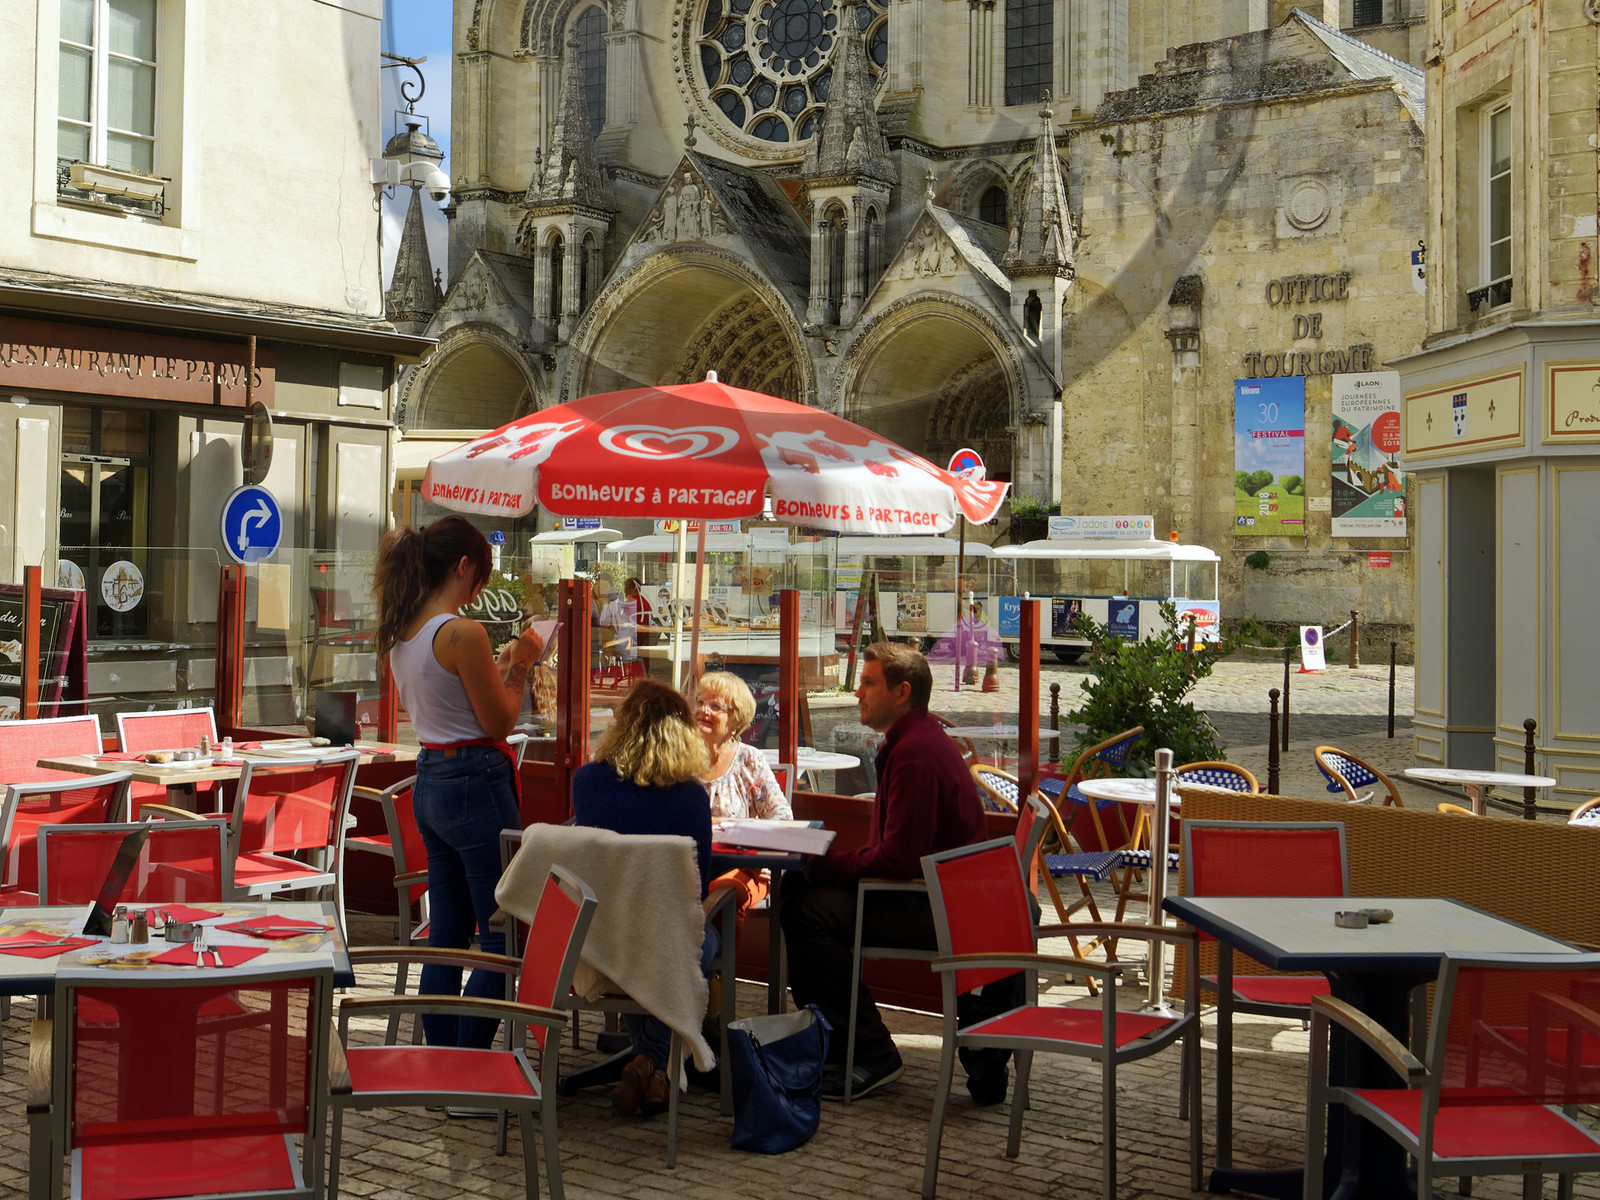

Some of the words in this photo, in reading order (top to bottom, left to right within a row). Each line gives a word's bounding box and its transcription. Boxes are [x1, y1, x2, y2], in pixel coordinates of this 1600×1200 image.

[1265, 274, 1350, 305] OFFICE
[1293, 313, 1322, 340] DE
[152, 356, 179, 380] LE
[1245, 348, 1373, 378] TOURISME
[1354, 404, 1396, 412] PATRIMOINE
[1252, 430, 1291, 438] FESTIVAL
[652, 486, 661, 503] à
[1259, 492, 1270, 516] 2018
[855, 505, 864, 520] à
